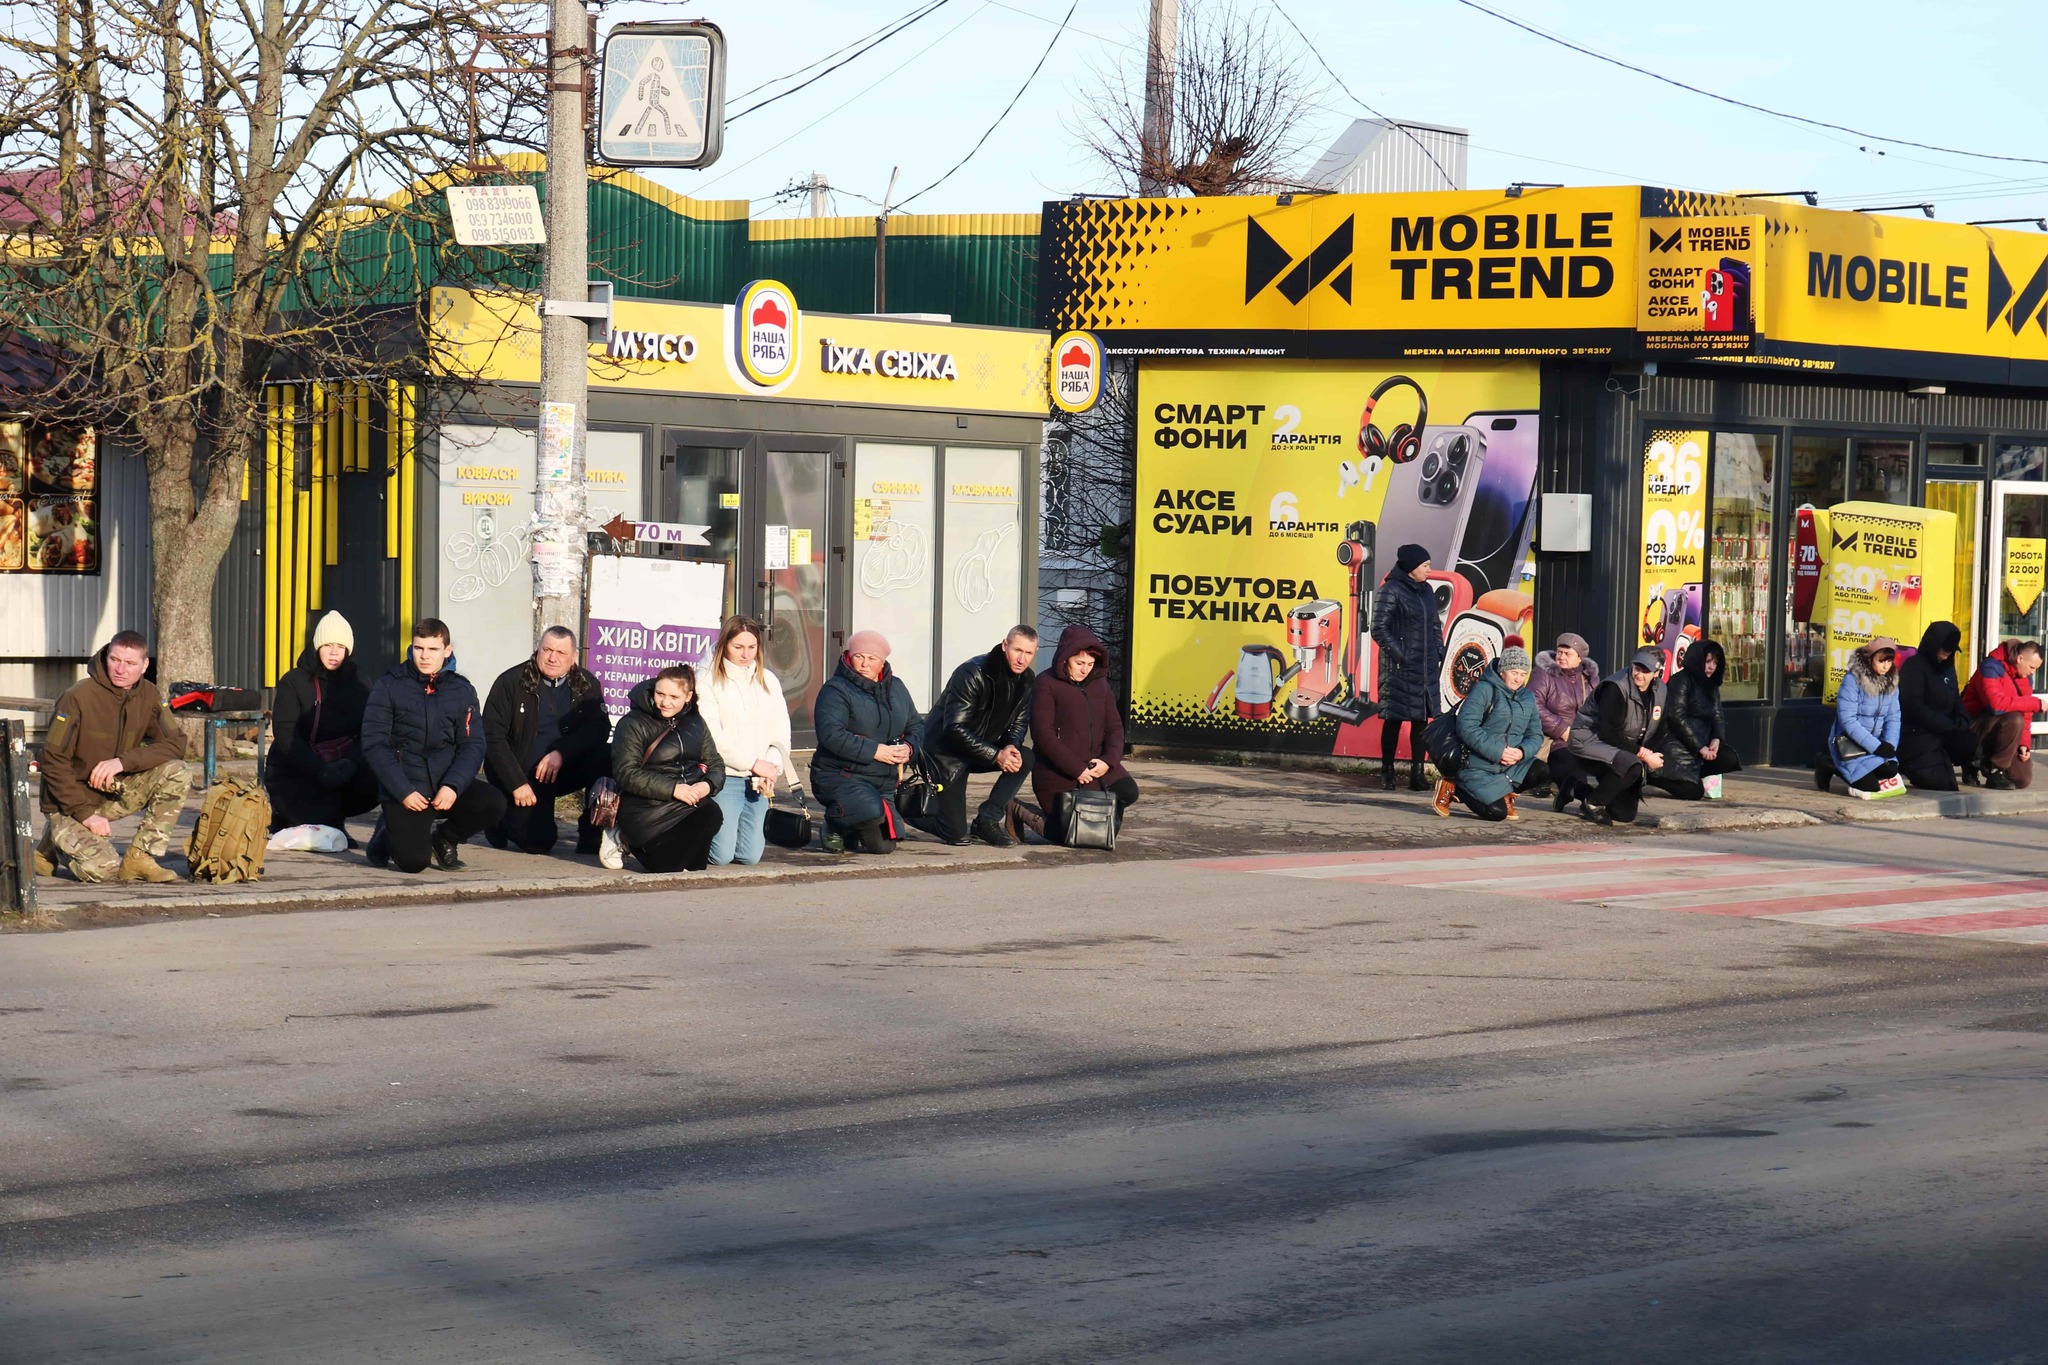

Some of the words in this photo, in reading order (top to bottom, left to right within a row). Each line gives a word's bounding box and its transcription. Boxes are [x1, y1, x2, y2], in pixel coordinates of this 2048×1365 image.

[466, 198, 486, 211] 098
[487, 196, 532, 210] 8399066
[489, 212, 533, 226] 7346010
[471, 228, 491, 242] 098
[492, 226, 535, 241] 5150193
[1391, 212, 1613, 251] MOBILE
[1688, 226, 1750, 238] MOBILE
[1688, 239, 1751, 251] TREND
[1390, 256, 1614, 300] TREND
[1648, 268, 1703, 277] СМАРТ
[1648, 279, 1694, 289] ФОНИ
[1807, 251, 1969, 310] MOBILE
[1648, 296, 1689, 306] АКСЕ
[1648, 307, 1698, 317] СУАРИ
[753, 331, 786, 344] НАША
[753, 345, 786, 360] РЯБА
[1504, 347, 1568, 355] МОБІЛЬНОГО
[1572, 347, 1612, 355] ЗВ'ЯЗКУ
[822, 338, 875, 374] ЇЖА
[877, 350, 958, 381] СВІЖА
[1745, 355, 1800, 367] МОБІЛЬНОГО
[1802, 359, 1835, 370] ЗВ'ЯЗКУ
[1061, 370, 1090, 381] НАША
[1061, 381, 1090, 393] РЯБА
[1154, 403, 1266, 426] СМАРТ
[1273, 404, 1302, 435] 2
[1154, 428, 1248, 450] ФОНИ
[1271, 434, 1342, 445] ГАРАНТІЯ
[457, 466, 519, 481] КОВБАСНІ
[1649, 440, 1702, 495] 36
[586, 469, 624, 483] ЯТИНА
[872, 480, 923, 495] СВИНИНА
[952, 482, 1014, 497] ЯЛОВИЧИНА
[1648, 484, 1690, 496] КРЕДИТ
[463, 491, 513, 506] ВИРОБИ
[1153, 489, 1235, 511] АКСЕ
[1269, 491, 1298, 530] 6
[636, 523, 660, 540] 70
[1152, 513, 1252, 536] СУАРИ
[1269, 521, 1339, 532] ГАРАНТІЯ
[1647, 509, 1705, 565] 0%
[1863, 532, 1917, 548] MOBILE
[1646, 543, 1667, 554] РОЗ
[1863, 543, 1917, 559] TREND
[2010, 551, 2043, 560] РОБОТА
[1645, 555, 1696, 566] СТРОЧКА
[1150, 573, 1320, 600] ПОБУТОВА
[1148, 597, 1285, 624] ТЕХНІКА
[596, 625, 648, 650] ЖИВІ
[652, 630, 711, 655] КВІТИ
[605, 654, 642, 667] БУКЕТИ
[603, 688, 632, 699] РОСЛ
